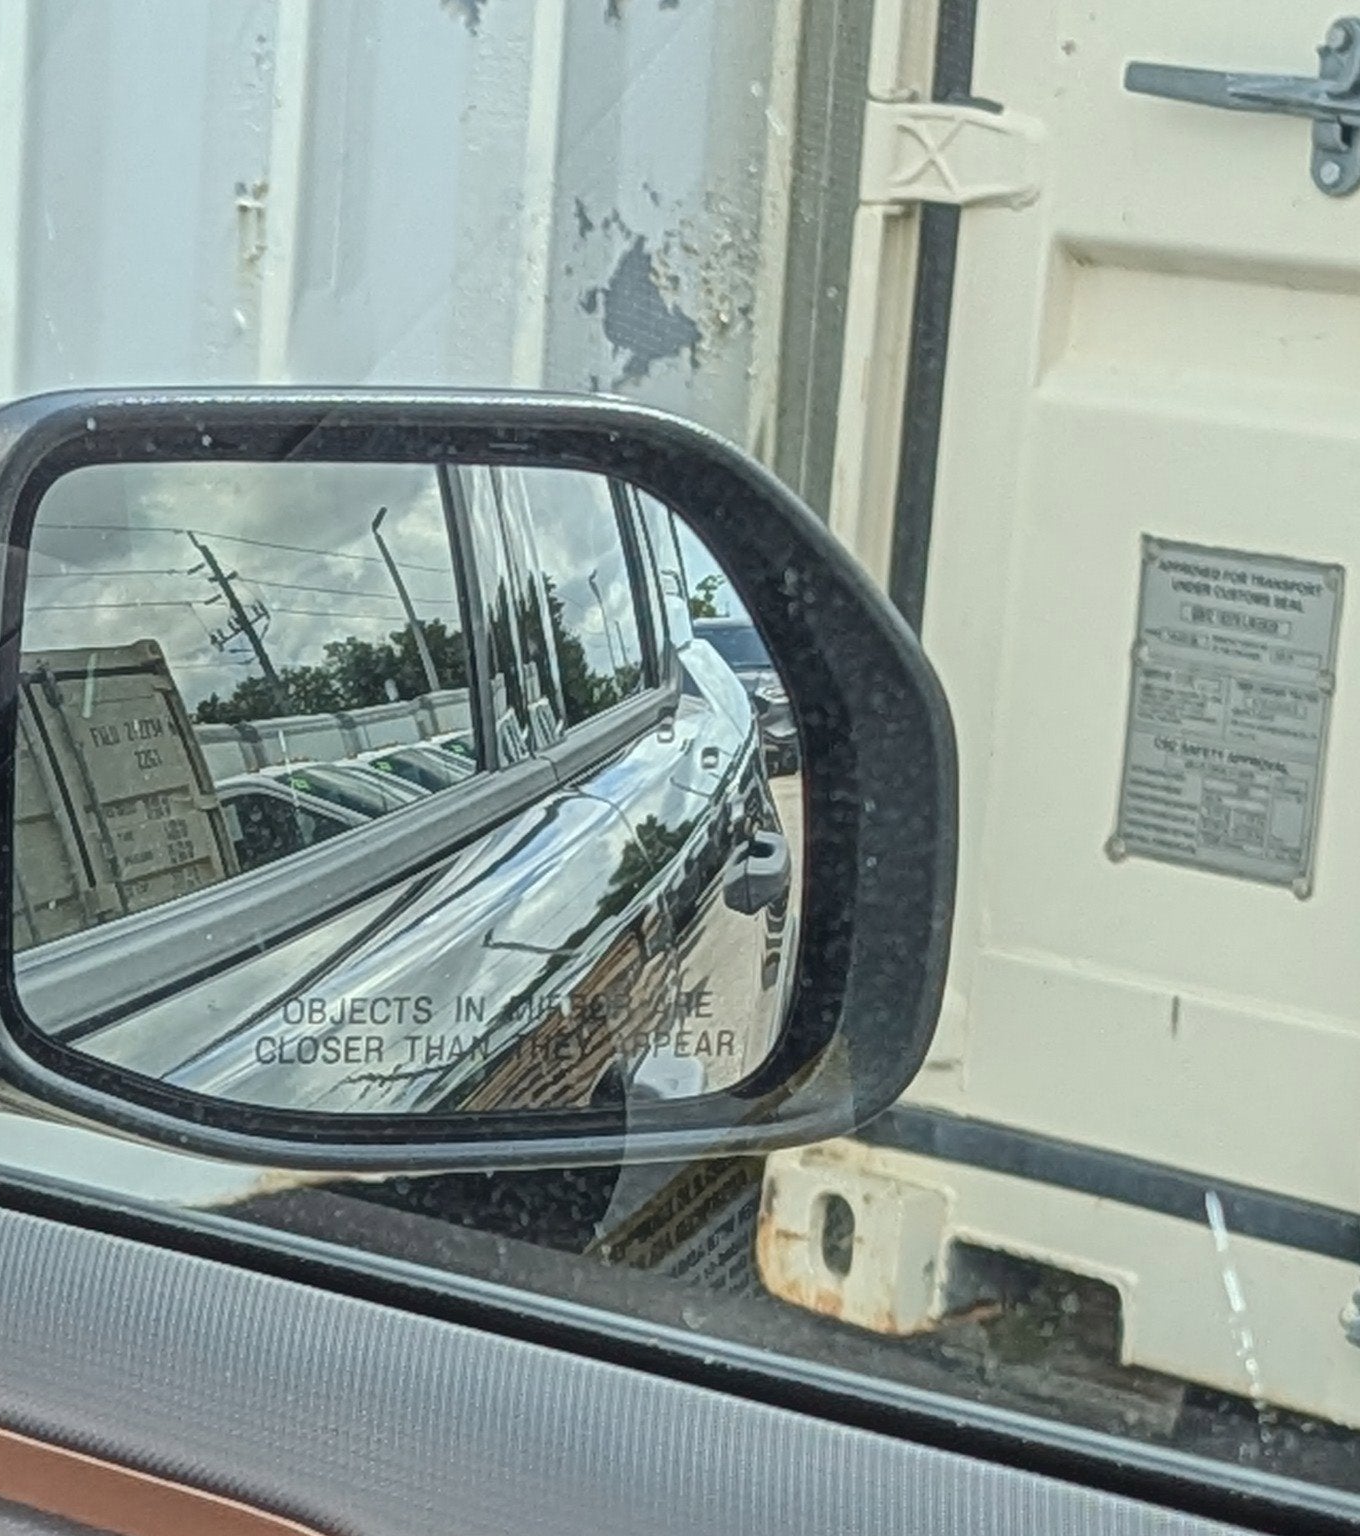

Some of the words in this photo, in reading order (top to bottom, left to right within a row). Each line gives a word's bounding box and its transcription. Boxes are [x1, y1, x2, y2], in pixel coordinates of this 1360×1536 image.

[281, 995, 433, 1026] OBJECTS
[455, 994, 485, 1024] IN
[654, 991, 715, 1019] ARE
[254, 1034, 384, 1066] CLOSER
[407, 1032, 490, 1063] THAN
[616, 1028, 735, 1059] APPEAR
